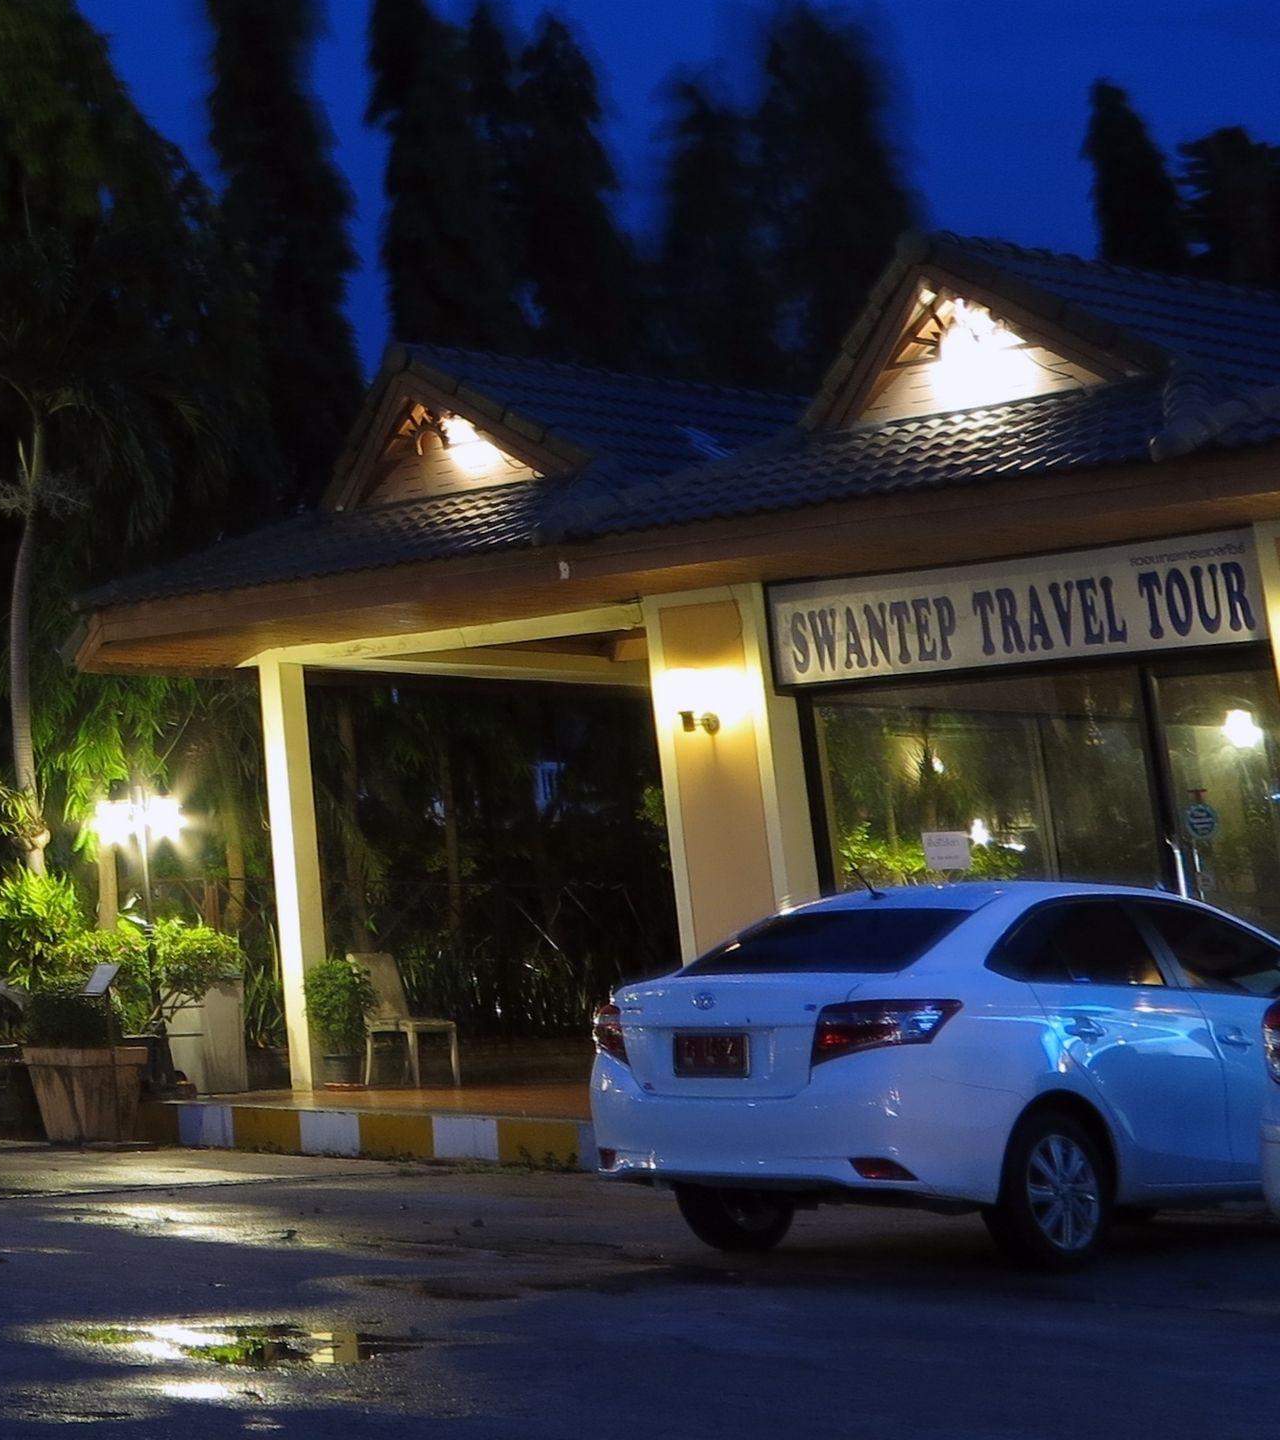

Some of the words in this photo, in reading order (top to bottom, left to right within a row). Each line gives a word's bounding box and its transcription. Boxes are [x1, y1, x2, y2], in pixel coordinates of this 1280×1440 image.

[790, 595, 957, 674] SWANTEP
[973, 576, 1128, 656] TRAVEL
[1138, 561, 1257, 640] TOUR
